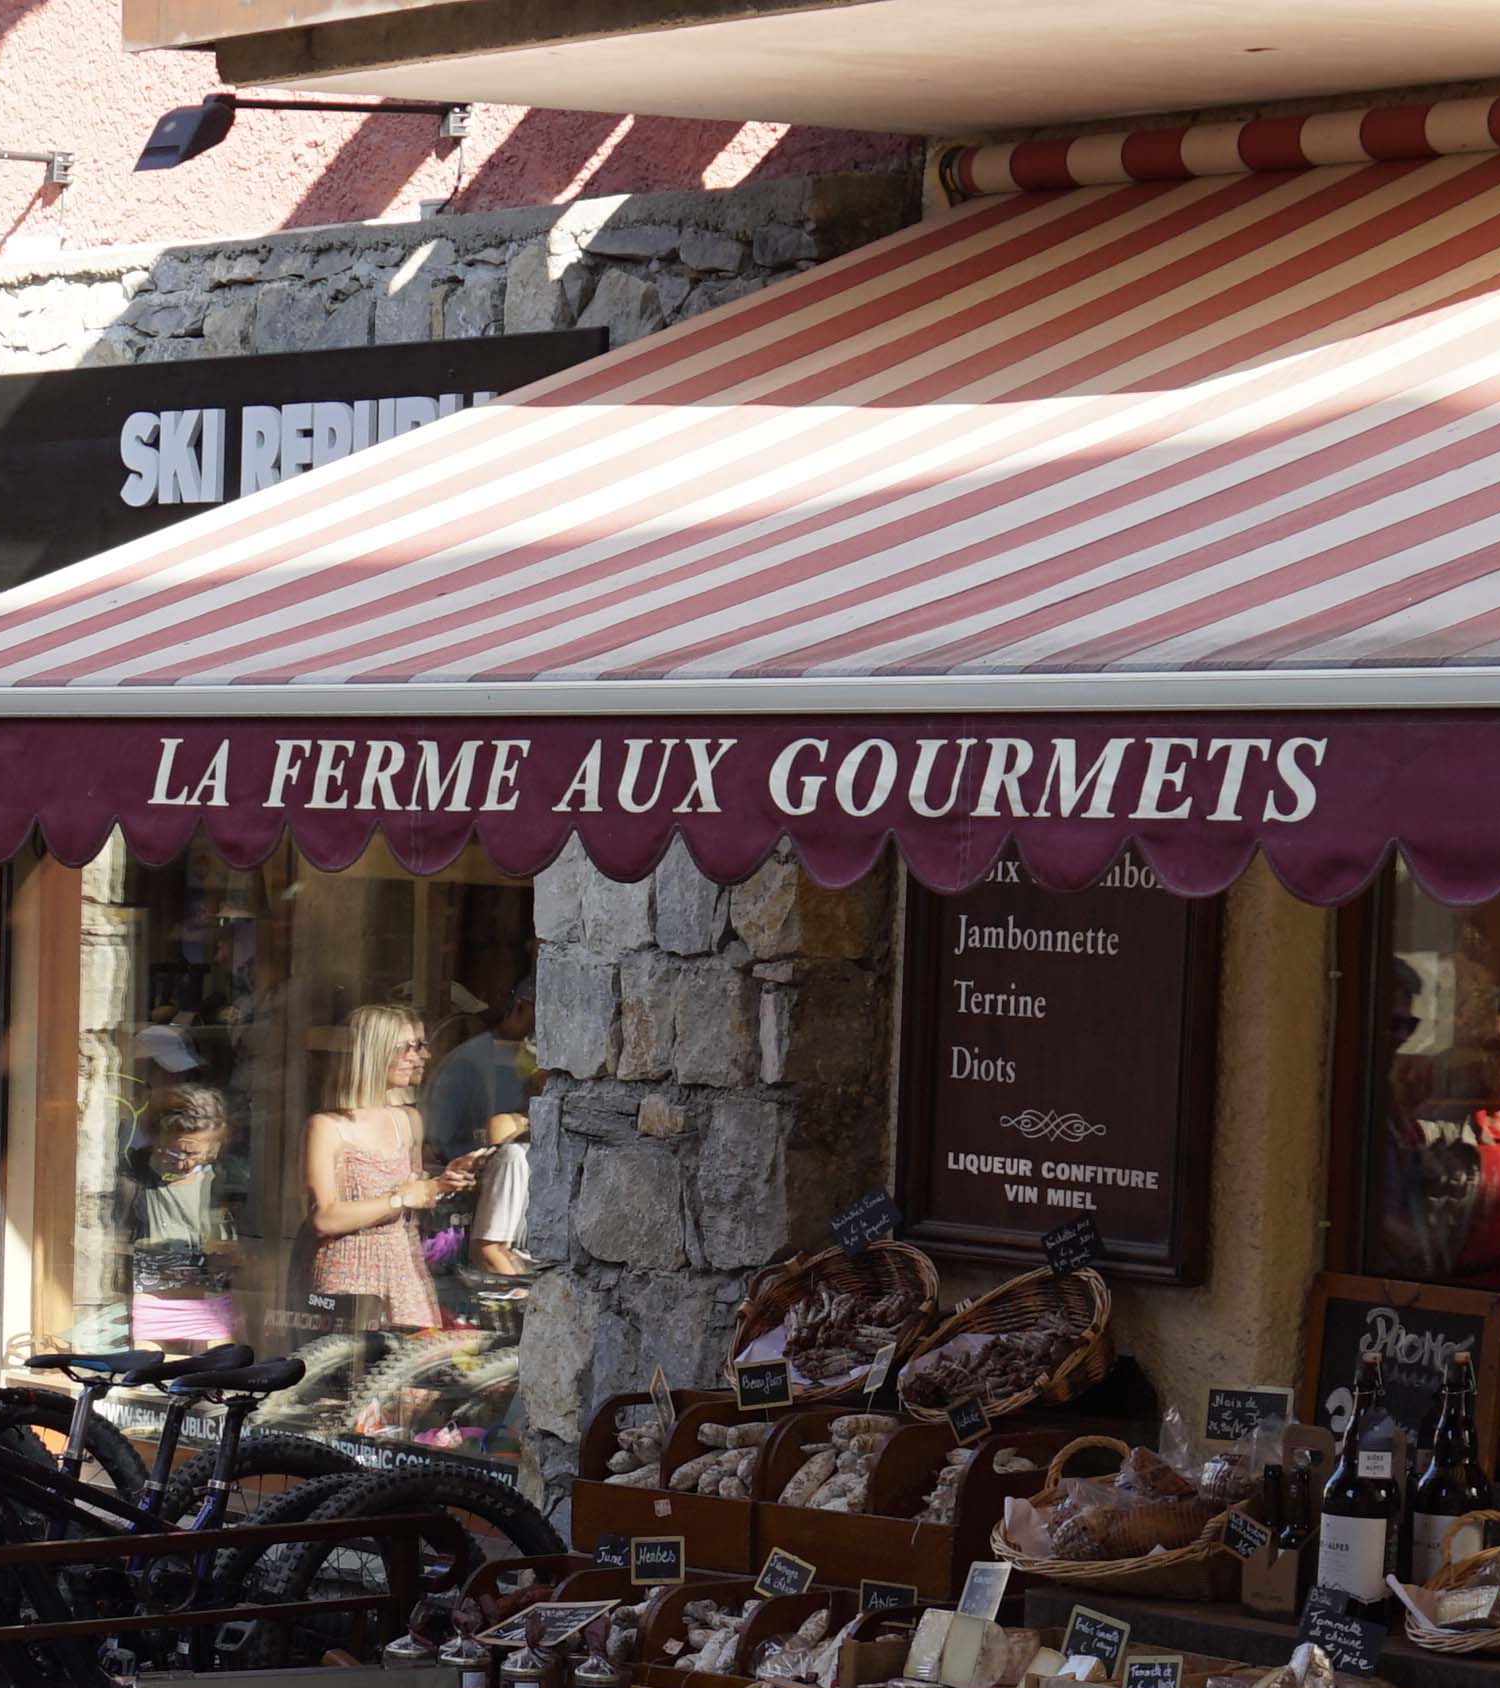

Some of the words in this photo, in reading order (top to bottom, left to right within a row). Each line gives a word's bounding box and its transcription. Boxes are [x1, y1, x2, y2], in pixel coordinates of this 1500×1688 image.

[119, 408, 227, 508] SKI
[240, 391, 499, 499] REPU
[147, 737, 232, 809] LA
[264, 737, 532, 813] FERME
[555, 738, 739, 814] AUX
[766, 735, 1331, 824] GOURMETS
[953, 914, 1120, 957] Jambonnette
[953, 979, 1047, 1019] Terrine
[950, 1046, 1017, 1084] Diots
[947, 1150, 1033, 1178] LIQUEUR
[1041, 1160, 1160, 1191] CONFITURE
[1004, 1183, 1039, 1205] VIN
[1046, 1188, 1098, 1211] MIEL
[308, 1293, 336, 1311] SINNER
